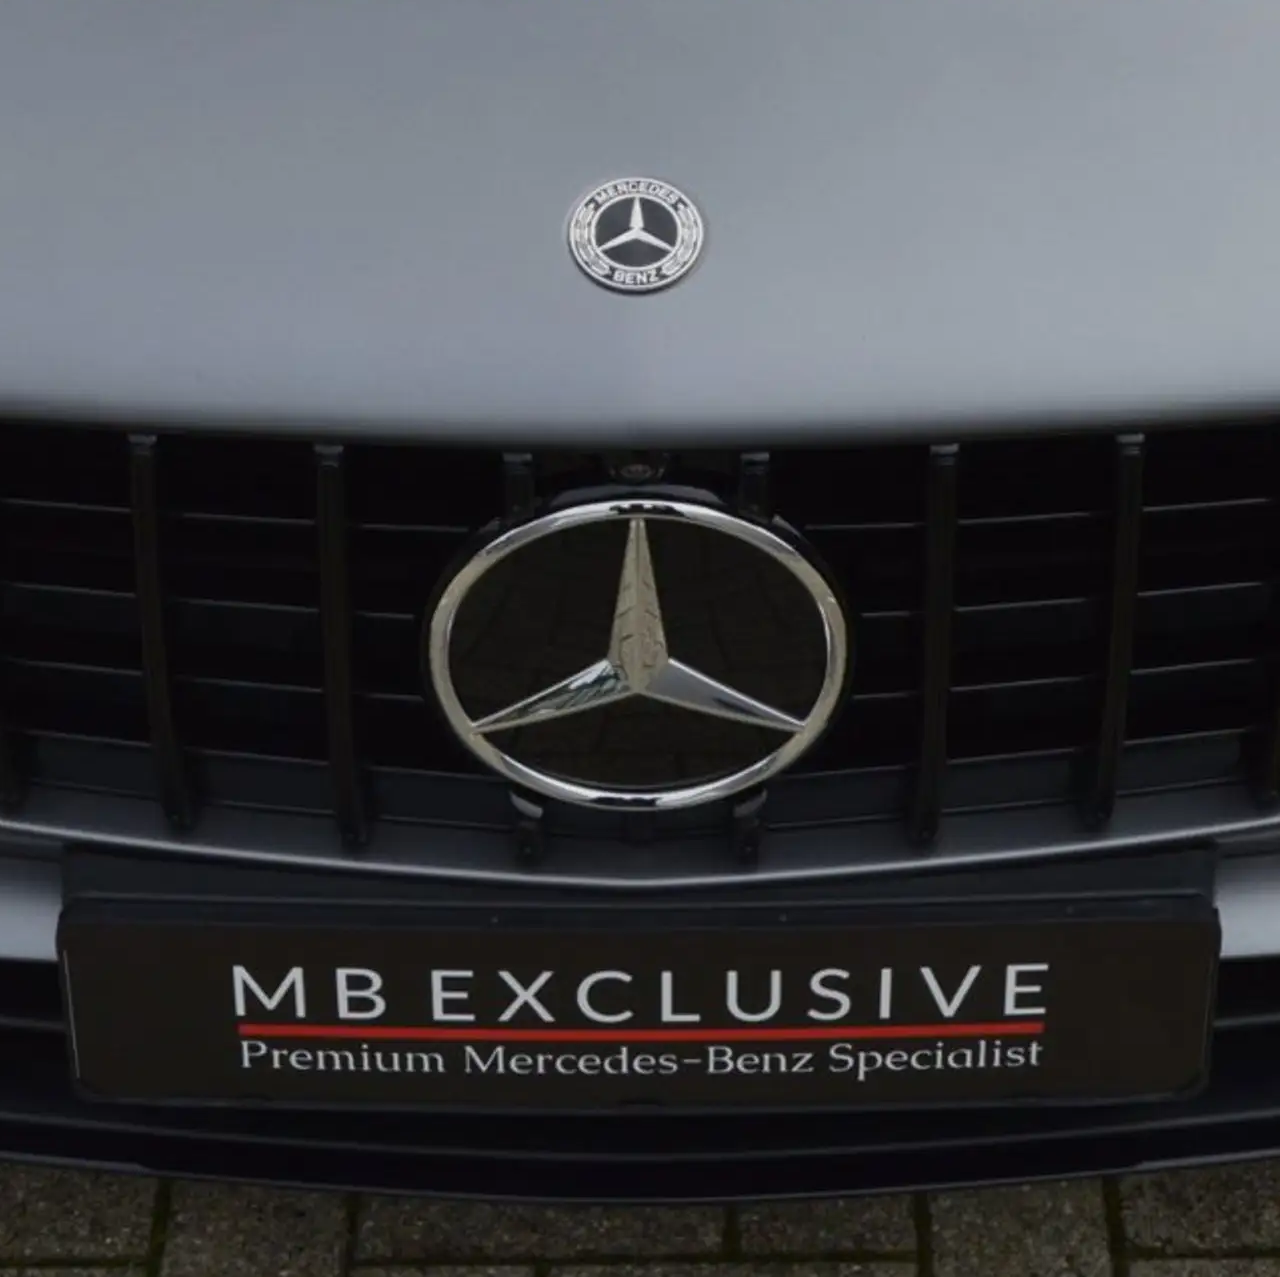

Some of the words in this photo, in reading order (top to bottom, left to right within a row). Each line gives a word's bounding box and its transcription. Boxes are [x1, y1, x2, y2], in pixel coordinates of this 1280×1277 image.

[595, 180, 679, 205] MERCEDES
[612, 269, 660, 285] BENZ
[231, 963, 387, 1021] MB
[429, 962, 1050, 1025] EXCLUSIVE
[240, 1039, 446, 1074] Premium
[463, 1044, 815, 1076] Mercedes-Benz
[828, 1038, 1044, 1082] Specialist
